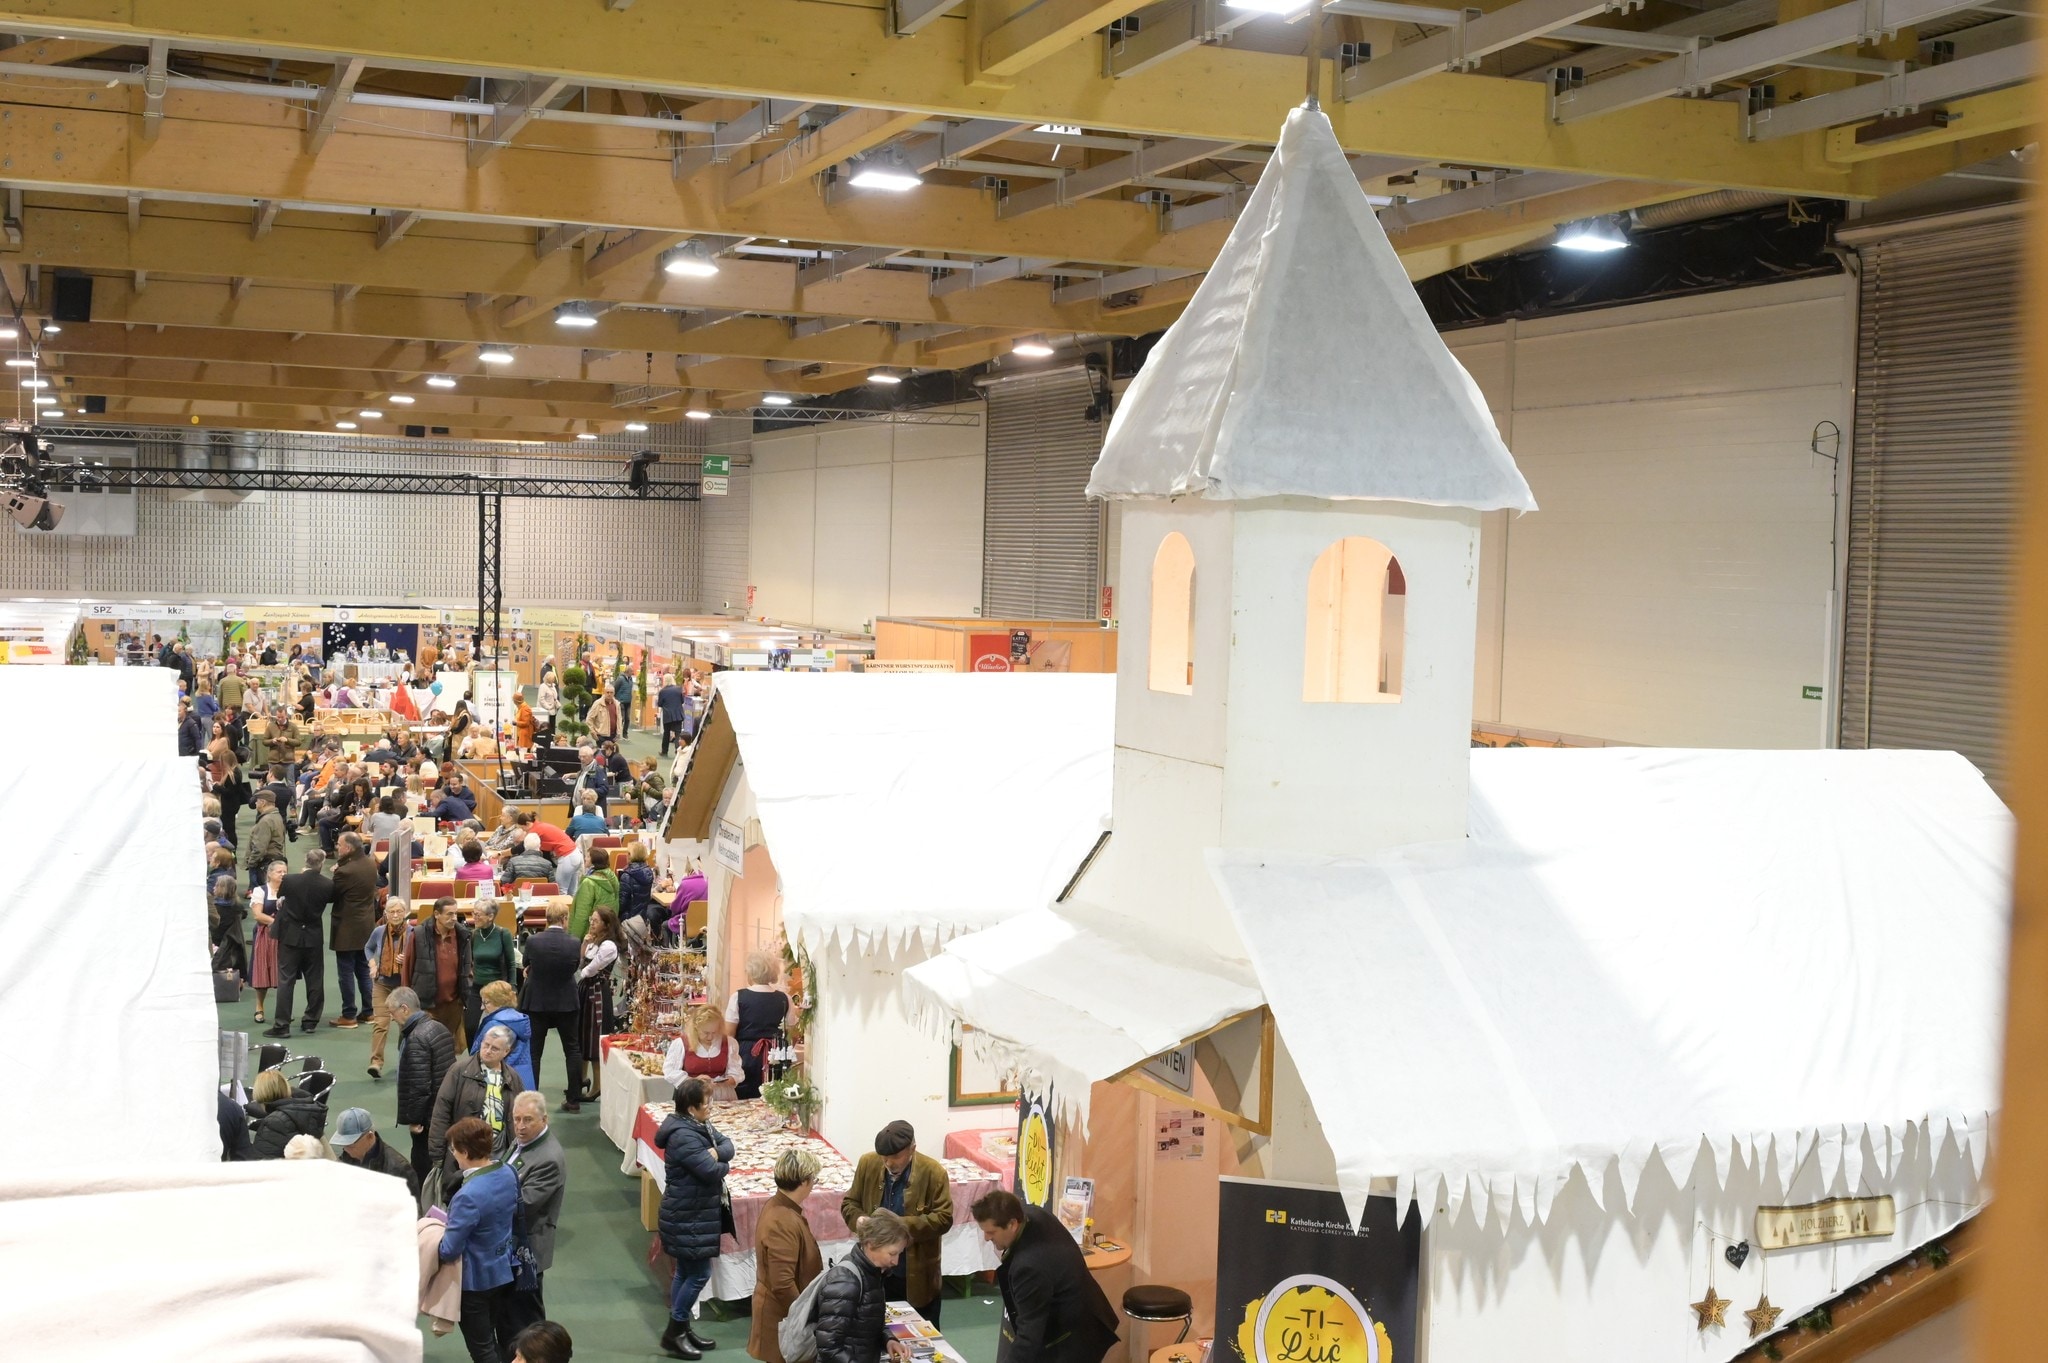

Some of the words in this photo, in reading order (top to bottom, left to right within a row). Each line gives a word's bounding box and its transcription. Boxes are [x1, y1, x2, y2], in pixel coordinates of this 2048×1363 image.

[93, 606, 113, 614] SPZ
[1290, 1217, 1324, 1229] Katholische
[1325, 1220, 1345, 1230] Kirche
[1801, 1216, 1844, 1231] HOLZHERZ
[1289, 1226, 1320, 1234] KATOLIŠKA
[1342, 1230, 1369, 1239] KORŠKA
